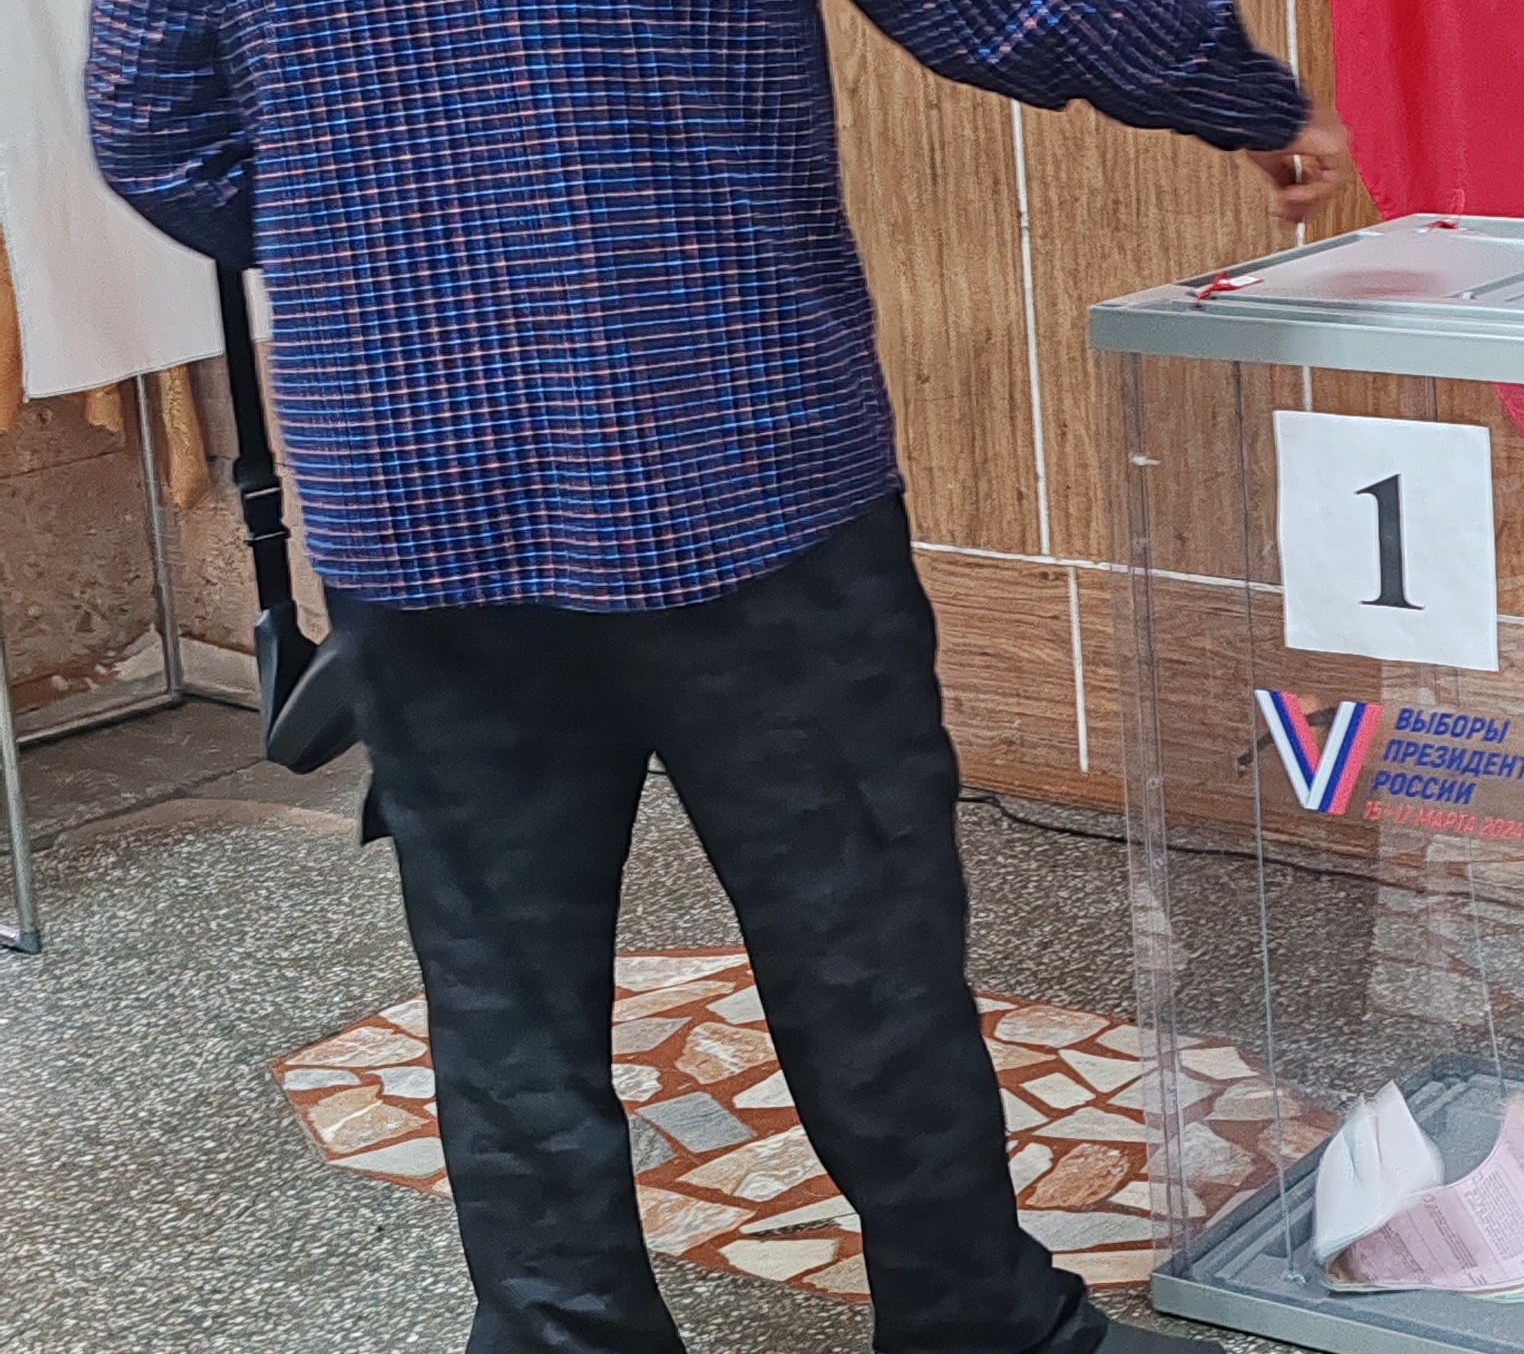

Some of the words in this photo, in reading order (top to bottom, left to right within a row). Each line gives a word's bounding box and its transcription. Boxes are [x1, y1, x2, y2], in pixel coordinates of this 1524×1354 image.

[1354, 473, 1425, 610] 1
[1395, 707, 1511, 743] ВЫБОРЫ
[1372, 770, 1477, 805] РОССИИ
[1415, 807, 1477, 833] МАРТА
[1480, 816, 1524, 841] 2024
